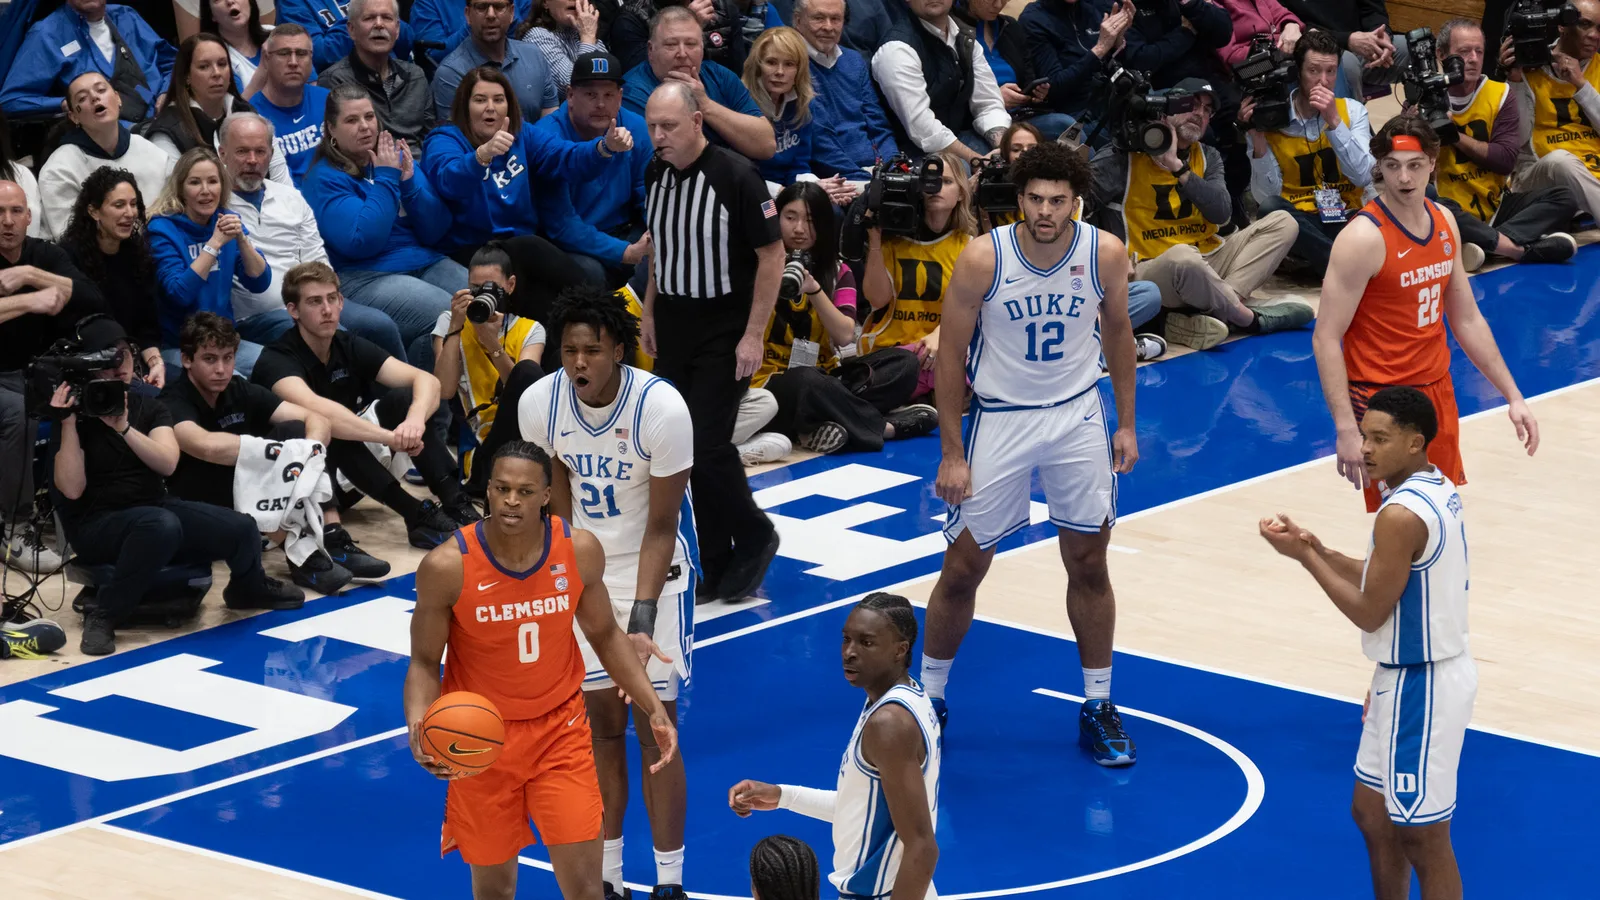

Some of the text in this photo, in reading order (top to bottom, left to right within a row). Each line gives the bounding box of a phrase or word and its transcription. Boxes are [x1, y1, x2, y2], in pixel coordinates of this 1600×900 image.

[591, 58, 609, 74] D
[897, 258, 943, 302] D
[893, 310, 941, 323] EDIA PHOT
[1003, 293, 1086, 321] DUKE
[1417, 283, 1441, 328] 22
[1025, 321, 1065, 361] 12
[563, 453, 633, 481] DUKE
[580, 482, 621, 519] 21
[475, 594, 570, 622] CLEMSON
[518, 622, 540, 664] 0
[1395, 772, 1417, 793] D
